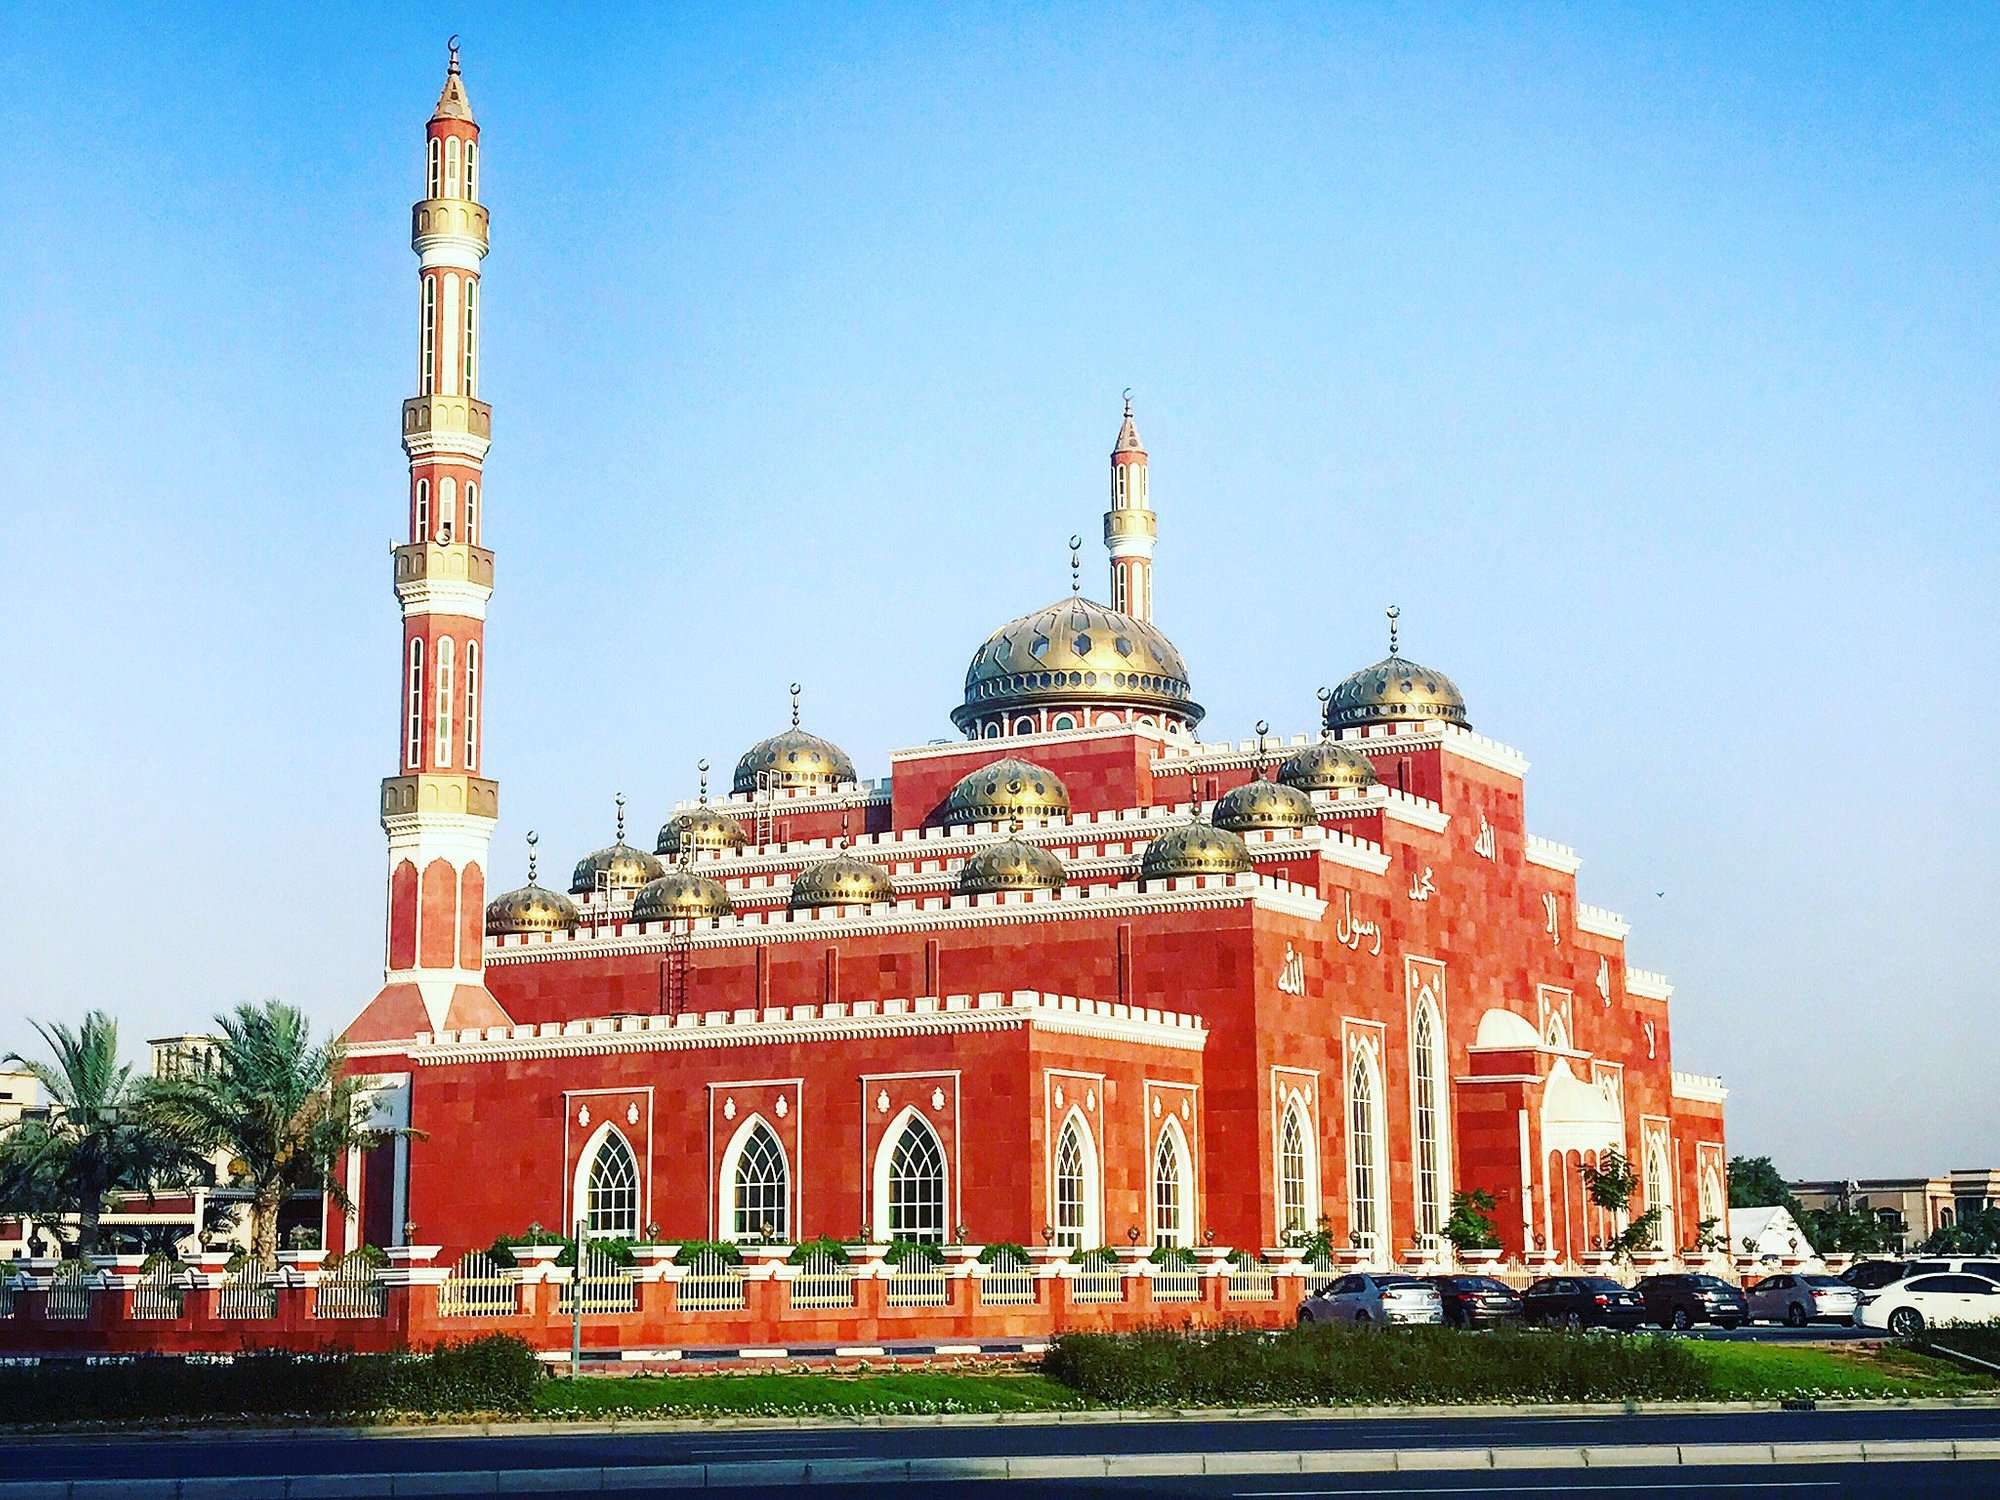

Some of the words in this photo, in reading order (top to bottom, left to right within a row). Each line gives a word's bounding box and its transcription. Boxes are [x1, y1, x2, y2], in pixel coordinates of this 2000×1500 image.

[1474, 814, 1496, 863] الله
[1408, 866, 1436, 901] محمد
[1336, 890, 1381, 956] رسول
[1278, 941, 1305, 997] الله
